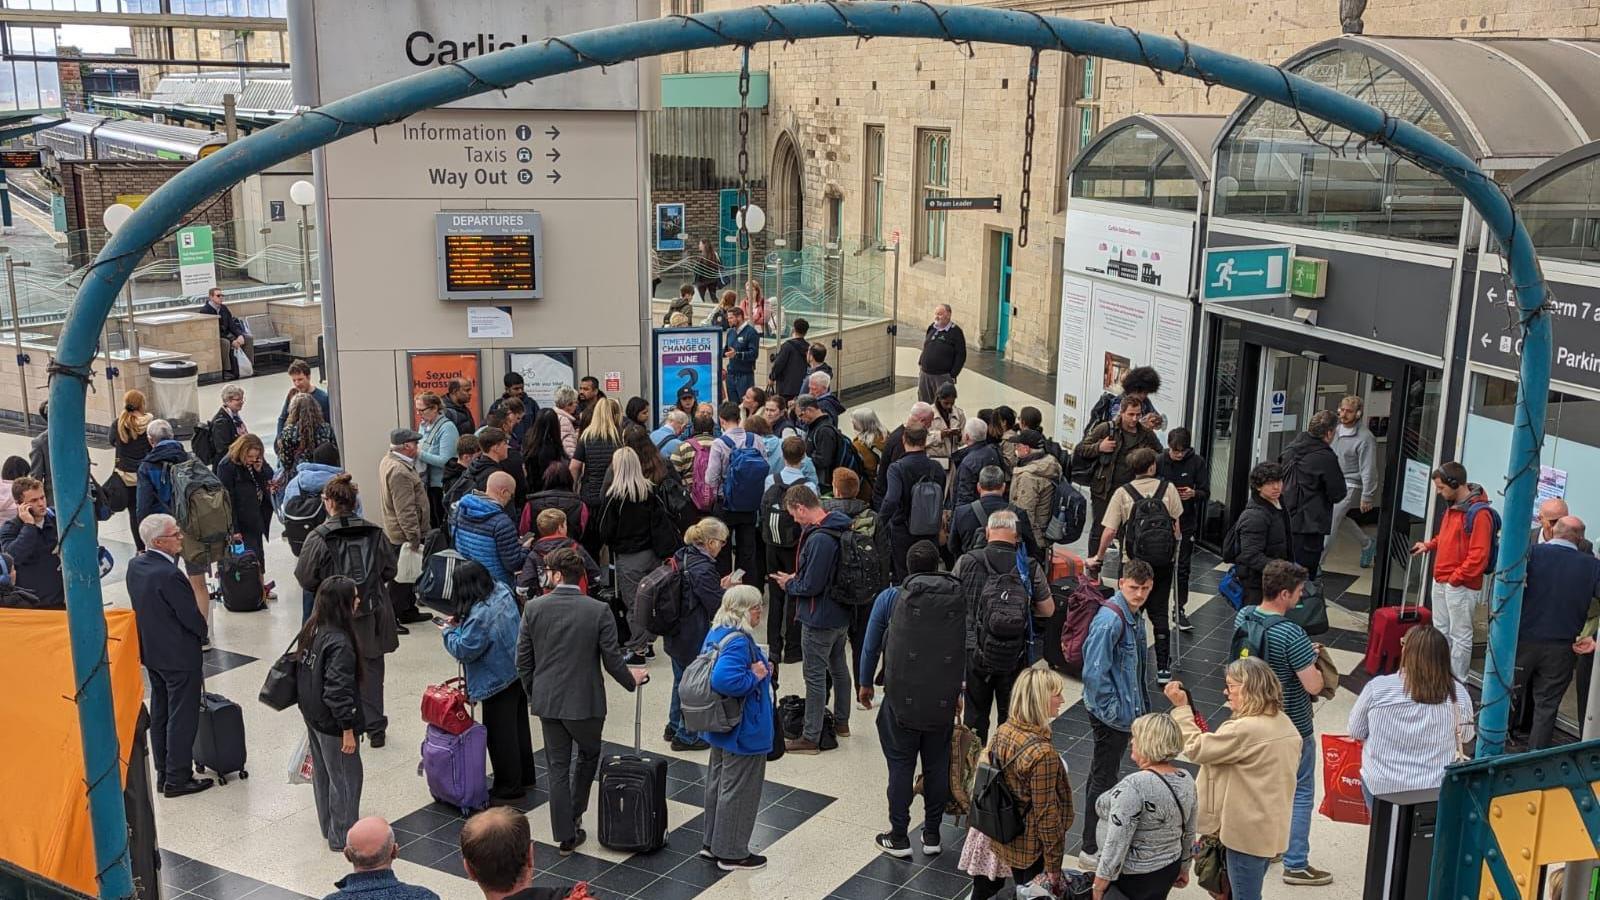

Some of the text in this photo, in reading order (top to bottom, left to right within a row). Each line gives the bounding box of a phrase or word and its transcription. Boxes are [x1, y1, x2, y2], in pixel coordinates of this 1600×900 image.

[405, 31, 528, 66] Carli
[403, 122, 507, 141] Information
[464, 146, 507, 163] Taxis
[429, 168, 508, 189] Way Out
[452, 215, 524, 226] DEPARTURES
[1582, 302, 1591, 319] 7
[662, 344, 697, 352] CHANGE
[663, 337, 711, 346] TIMETABLES
[675, 355, 698, 364] JUNE
[1557, 346, 1600, 372] Parkin
[426, 370, 462, 380] Sexual
[414, 377, 476, 389] Harasst
